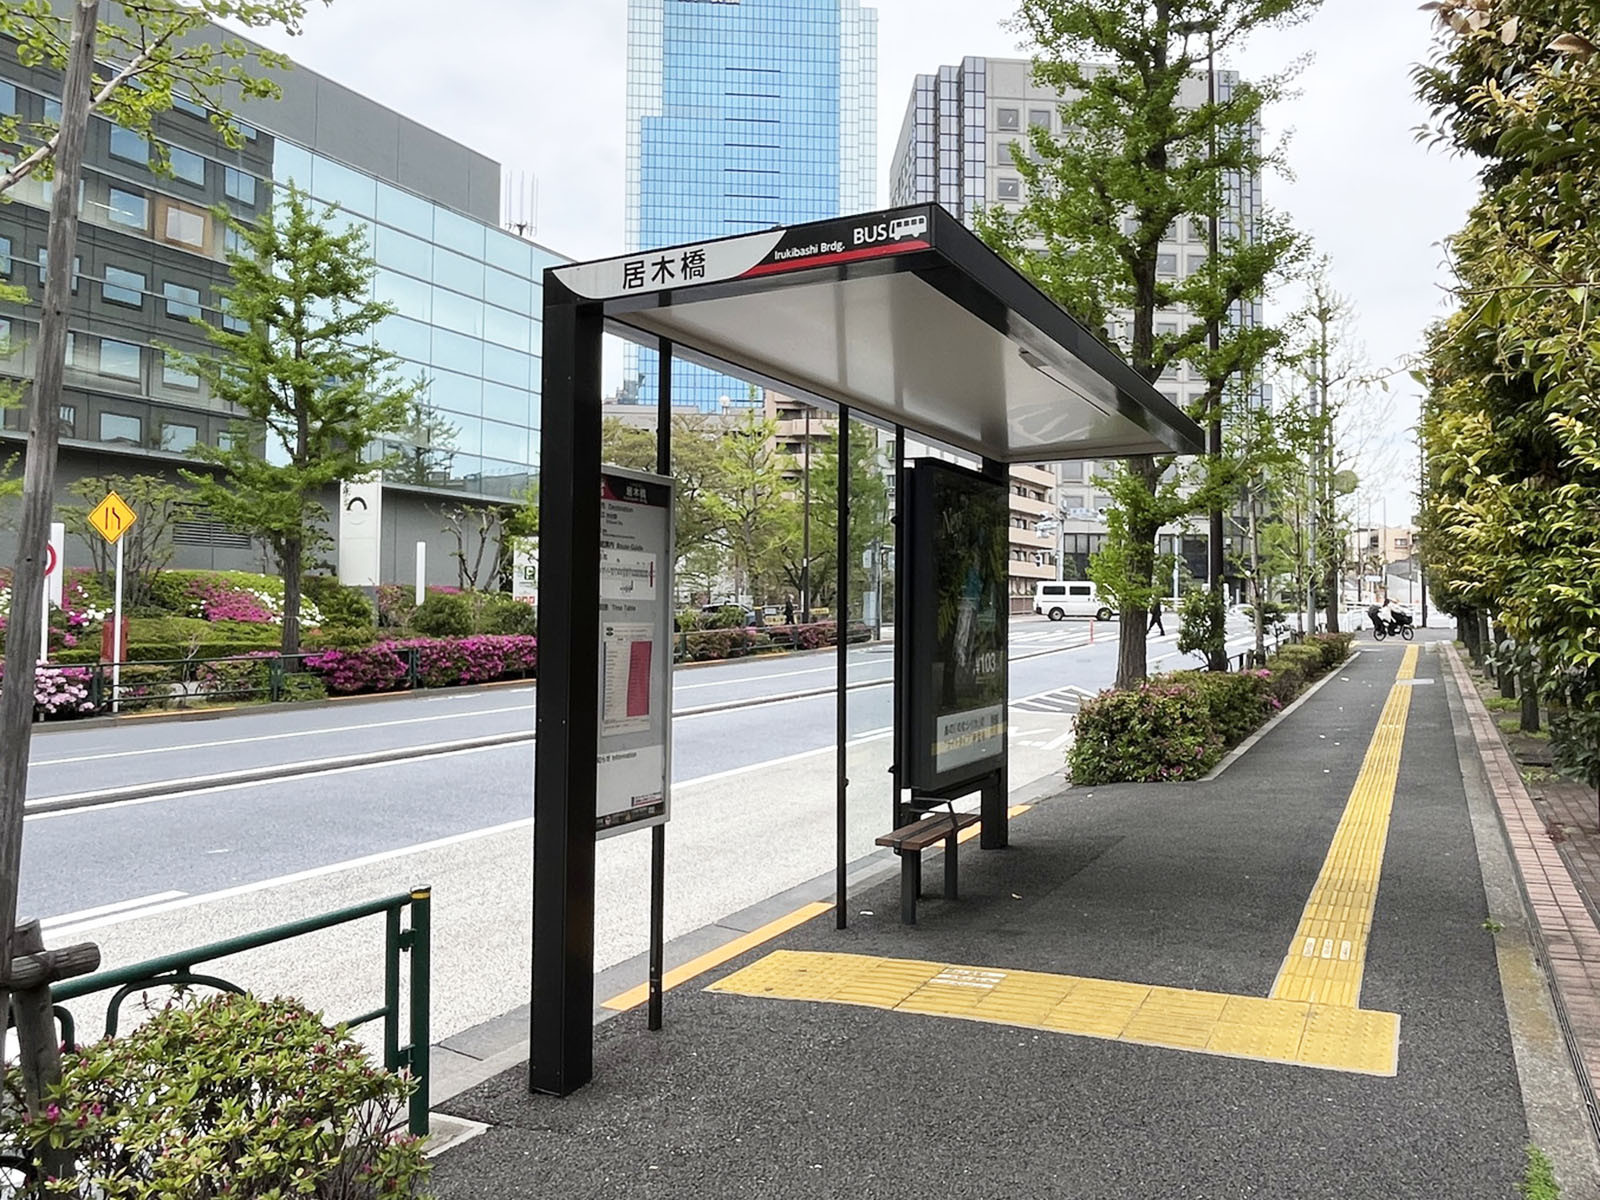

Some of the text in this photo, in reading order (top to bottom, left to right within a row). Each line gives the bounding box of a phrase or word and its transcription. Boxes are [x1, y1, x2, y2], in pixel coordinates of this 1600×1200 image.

[853, 224, 888, 245] BUS
[774, 240, 846, 260] Irukibashi Brdg.
[622, 248, 706, 290] 居木橋
